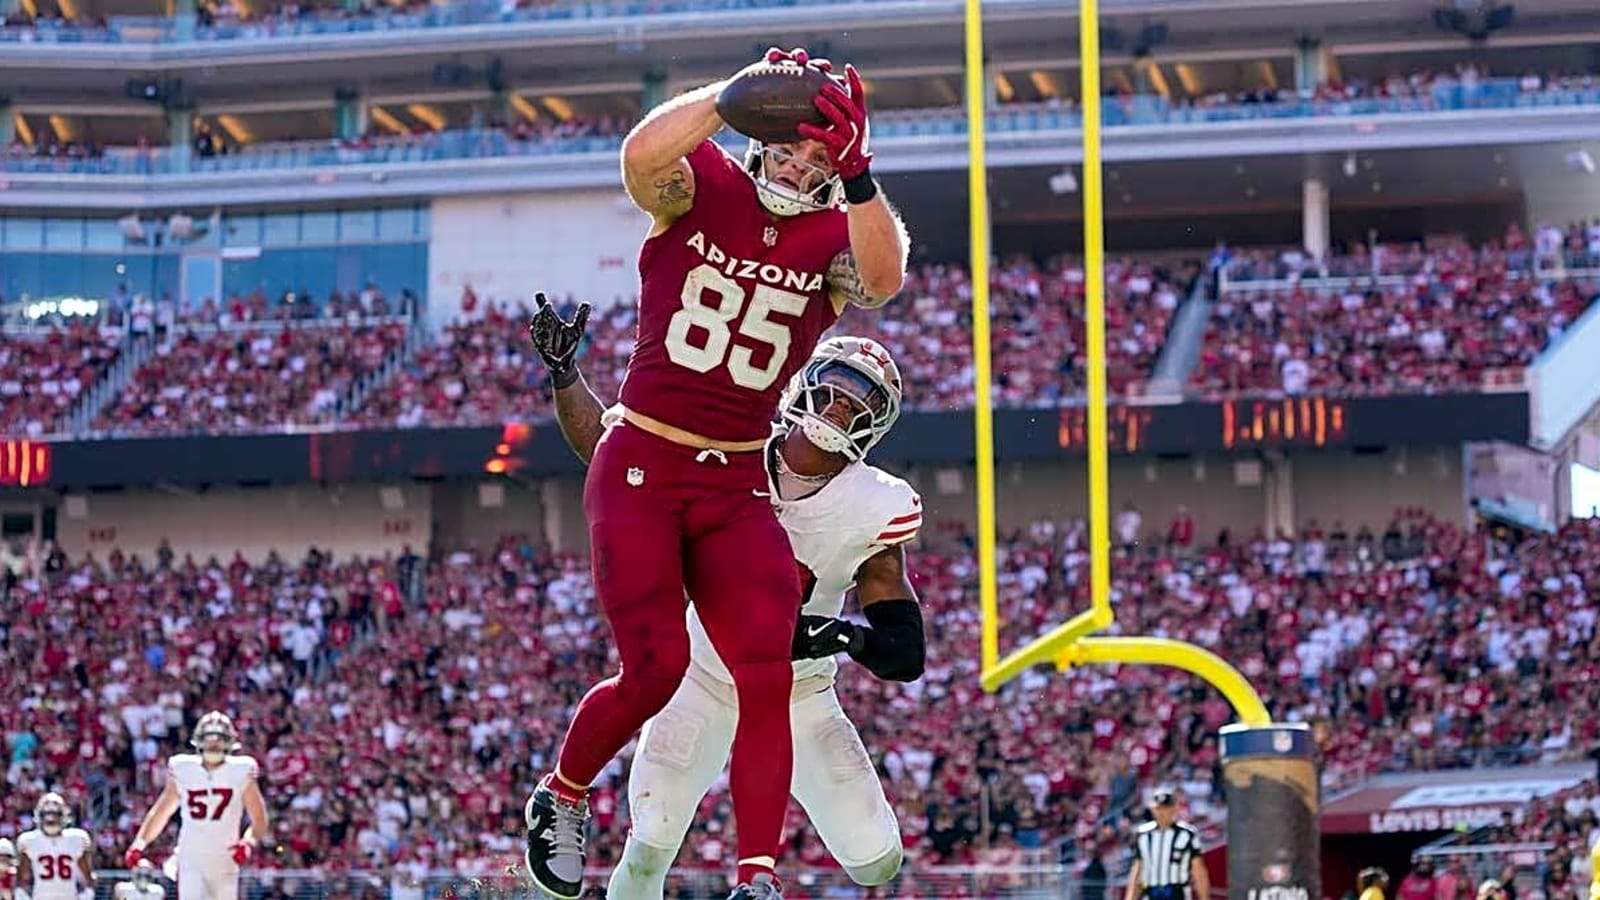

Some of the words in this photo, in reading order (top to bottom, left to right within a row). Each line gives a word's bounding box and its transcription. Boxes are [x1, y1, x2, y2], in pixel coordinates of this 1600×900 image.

[686, 230, 824, 292] ARIZONA
[664, 263, 810, 391] 85
[187, 788, 233, 820] 57
[38, 854, 72, 880] 36
